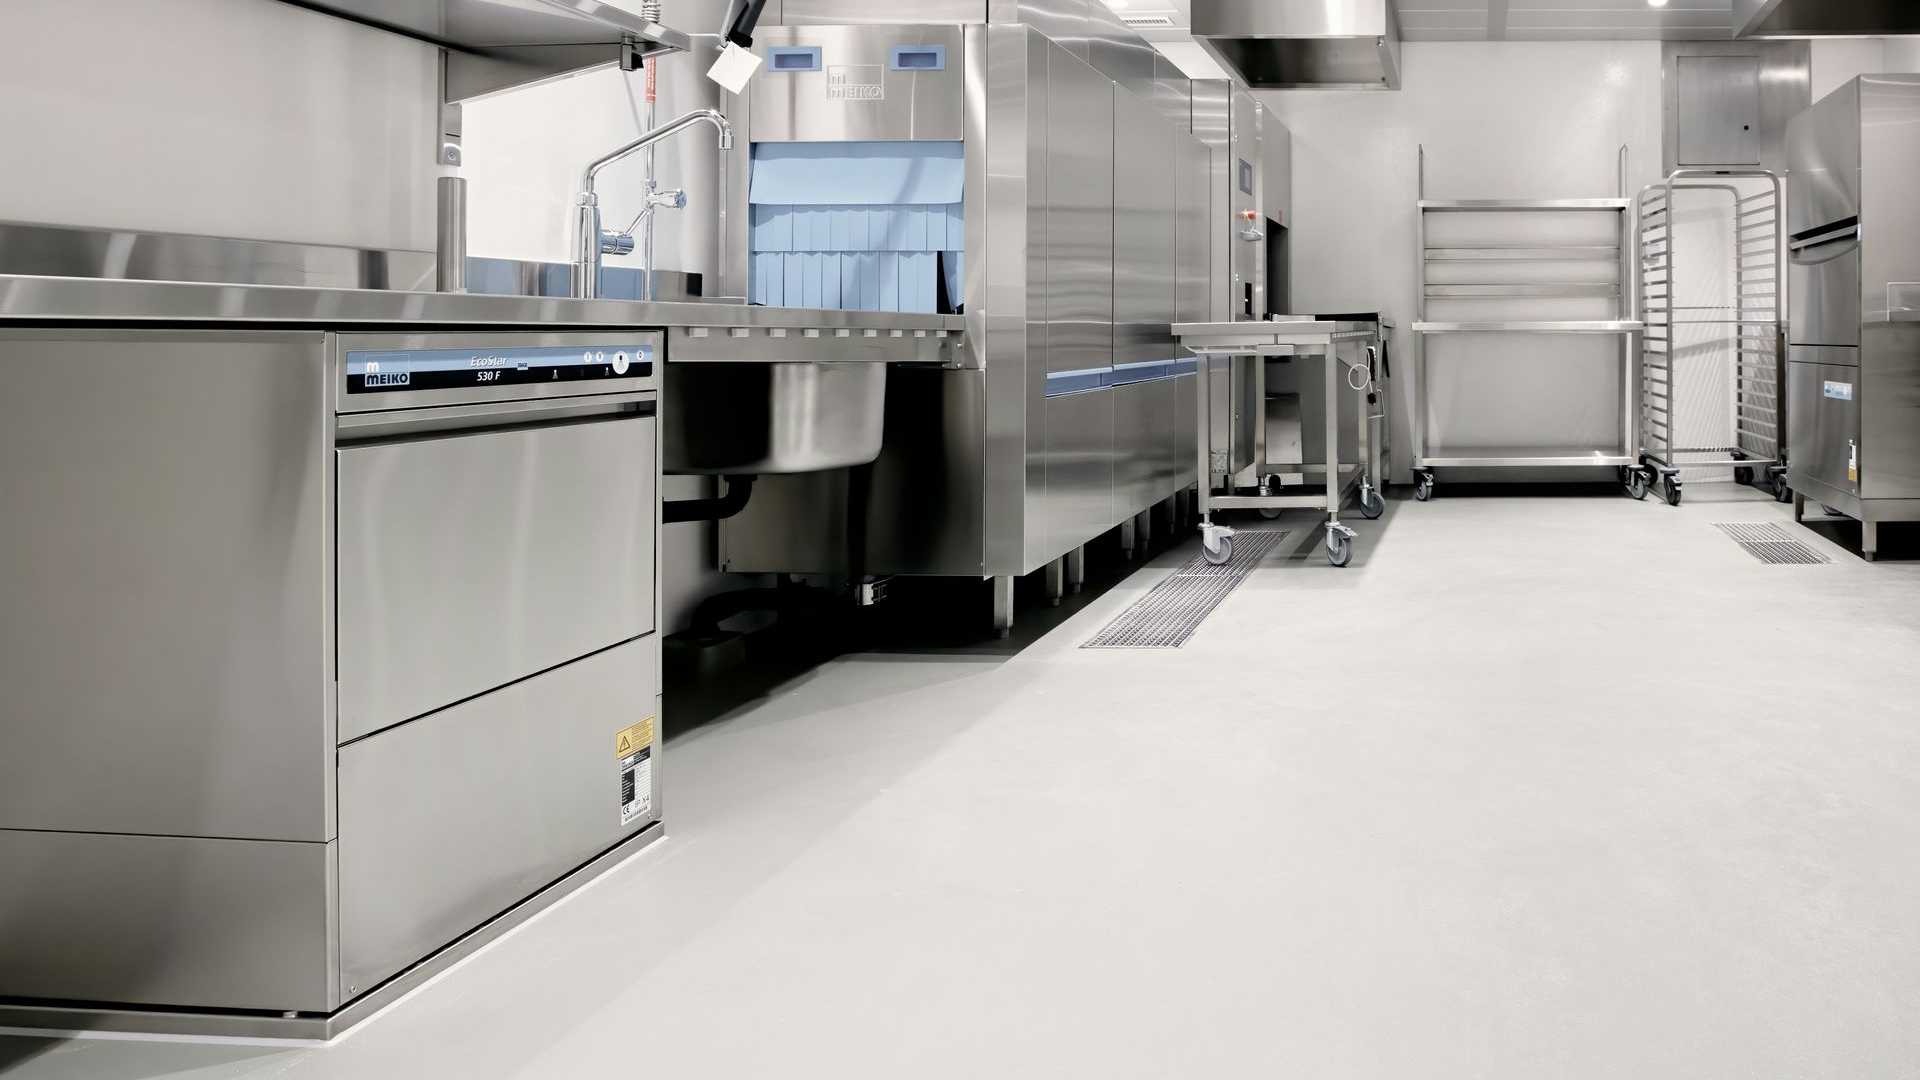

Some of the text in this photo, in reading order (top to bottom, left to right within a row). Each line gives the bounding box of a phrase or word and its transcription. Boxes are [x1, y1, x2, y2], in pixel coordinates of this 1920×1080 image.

[831, 86, 881, 98] MEIKO
[470, 356, 508, 367] EcoStar
[366, 373, 409, 385] MEIKO
[477, 371, 501, 381] 530 F
